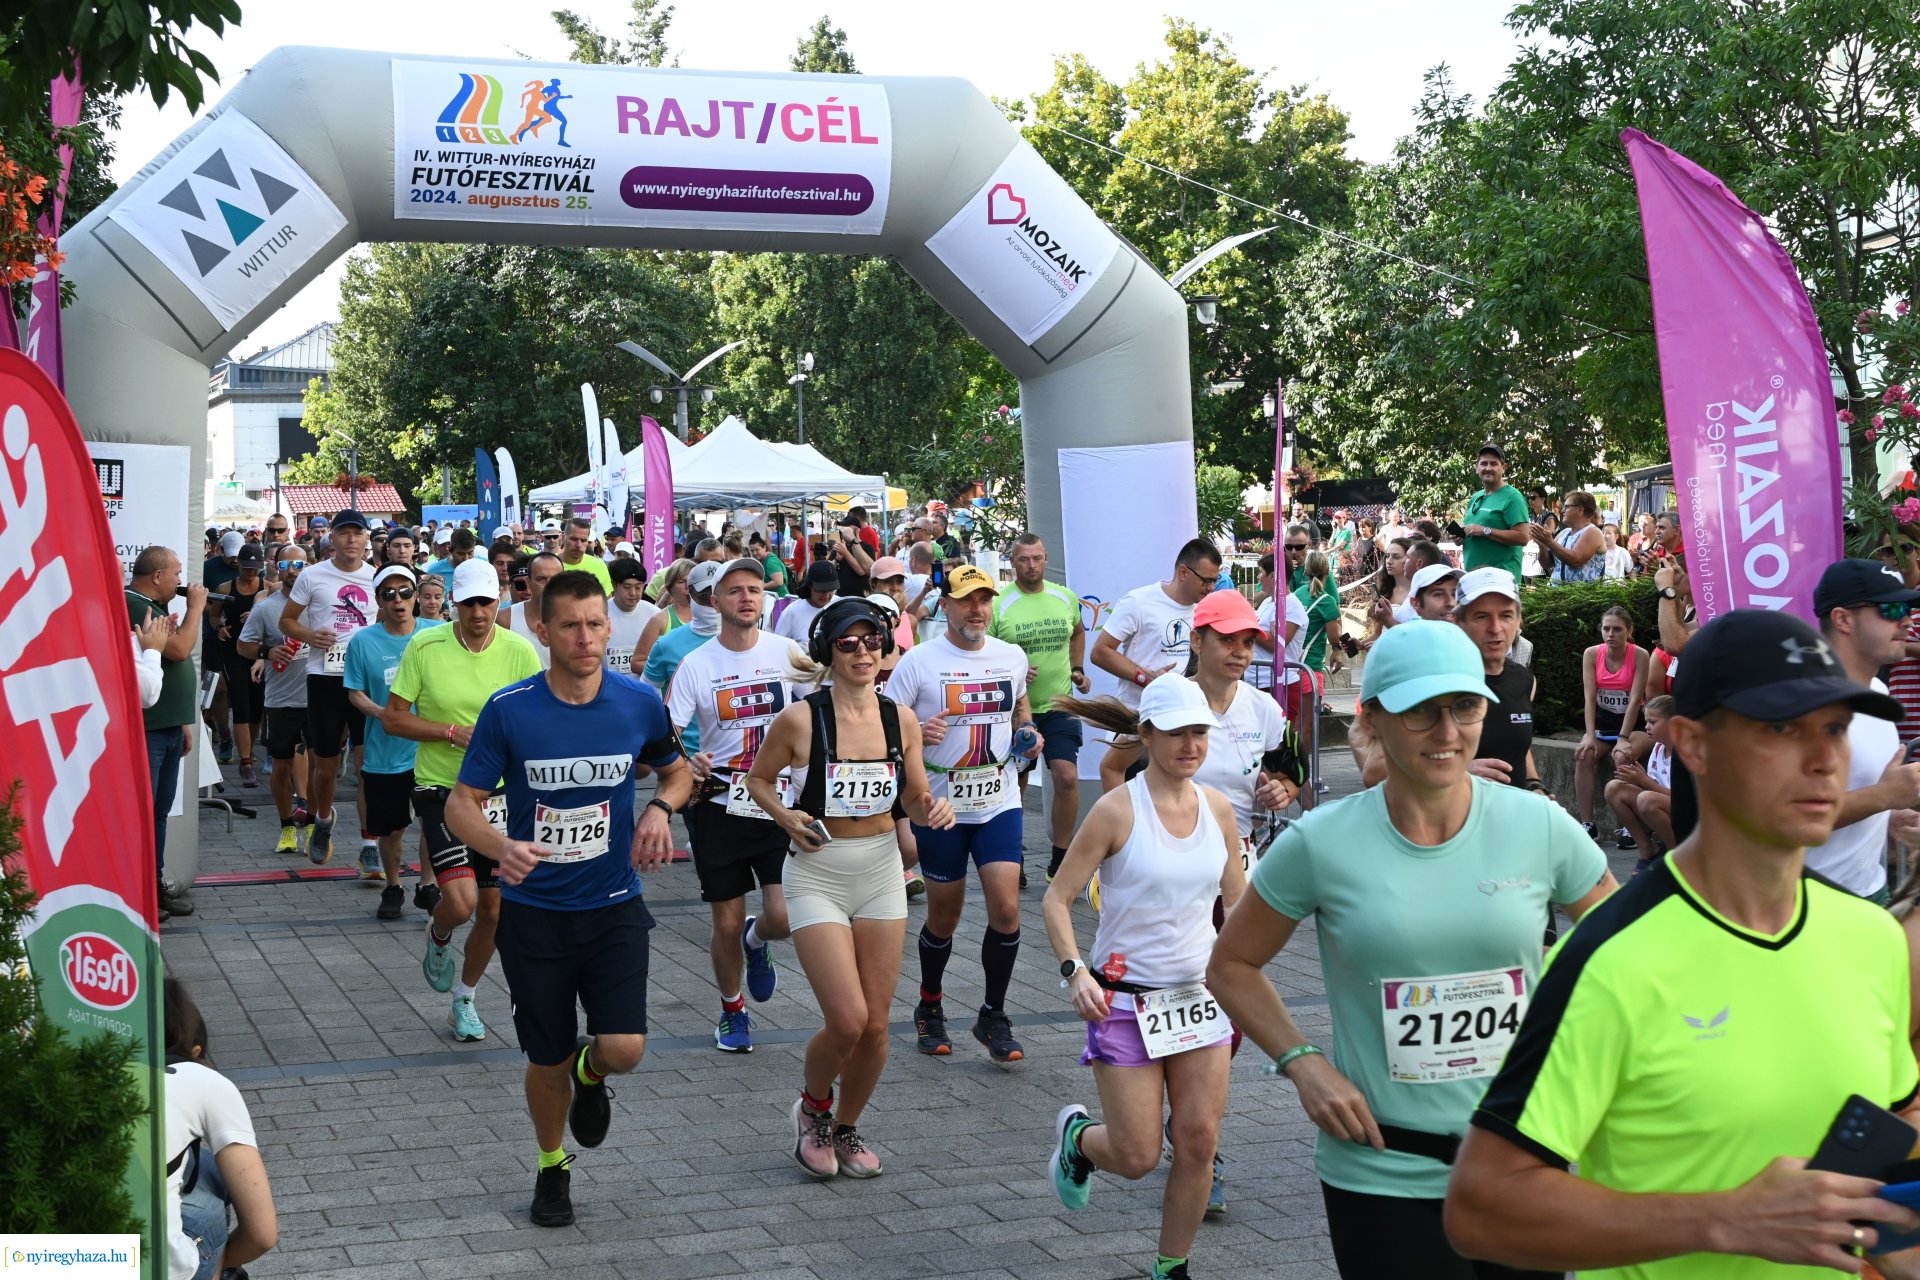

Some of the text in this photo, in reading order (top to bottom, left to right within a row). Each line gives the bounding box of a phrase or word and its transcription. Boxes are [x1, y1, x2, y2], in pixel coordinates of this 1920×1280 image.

[616, 95, 879, 145] RAJT/CÉL
[414, 149, 596, 170] IV. WITTUR-NYÍREGYHÁZI
[411, 164, 595, 194] FUTÓFESZTIVÁL
[410, 188, 593, 210] 2024. augusztus 25.
[633, 182, 861, 202] www.nyiregyhazifutofesztival.hu
[237, 224, 298, 279] WITTUR
[1013, 243, 1032, 264] orvosi
[1018, 216, 1087, 284] MOZAIK
[1055, 270, 1078, 291] med
[1022, 622, 1034, 630] ben
[1044, 618, 1051, 626] 40
[1599, 695, 1630, 705] 10018
[832, 781, 892, 799] 21136
[953, 779, 1001, 798] 21128
[540, 820, 605, 846] 21126
[1146, 999, 1218, 1035] 21165
[1398, 1002, 1520, 1047] 21204
